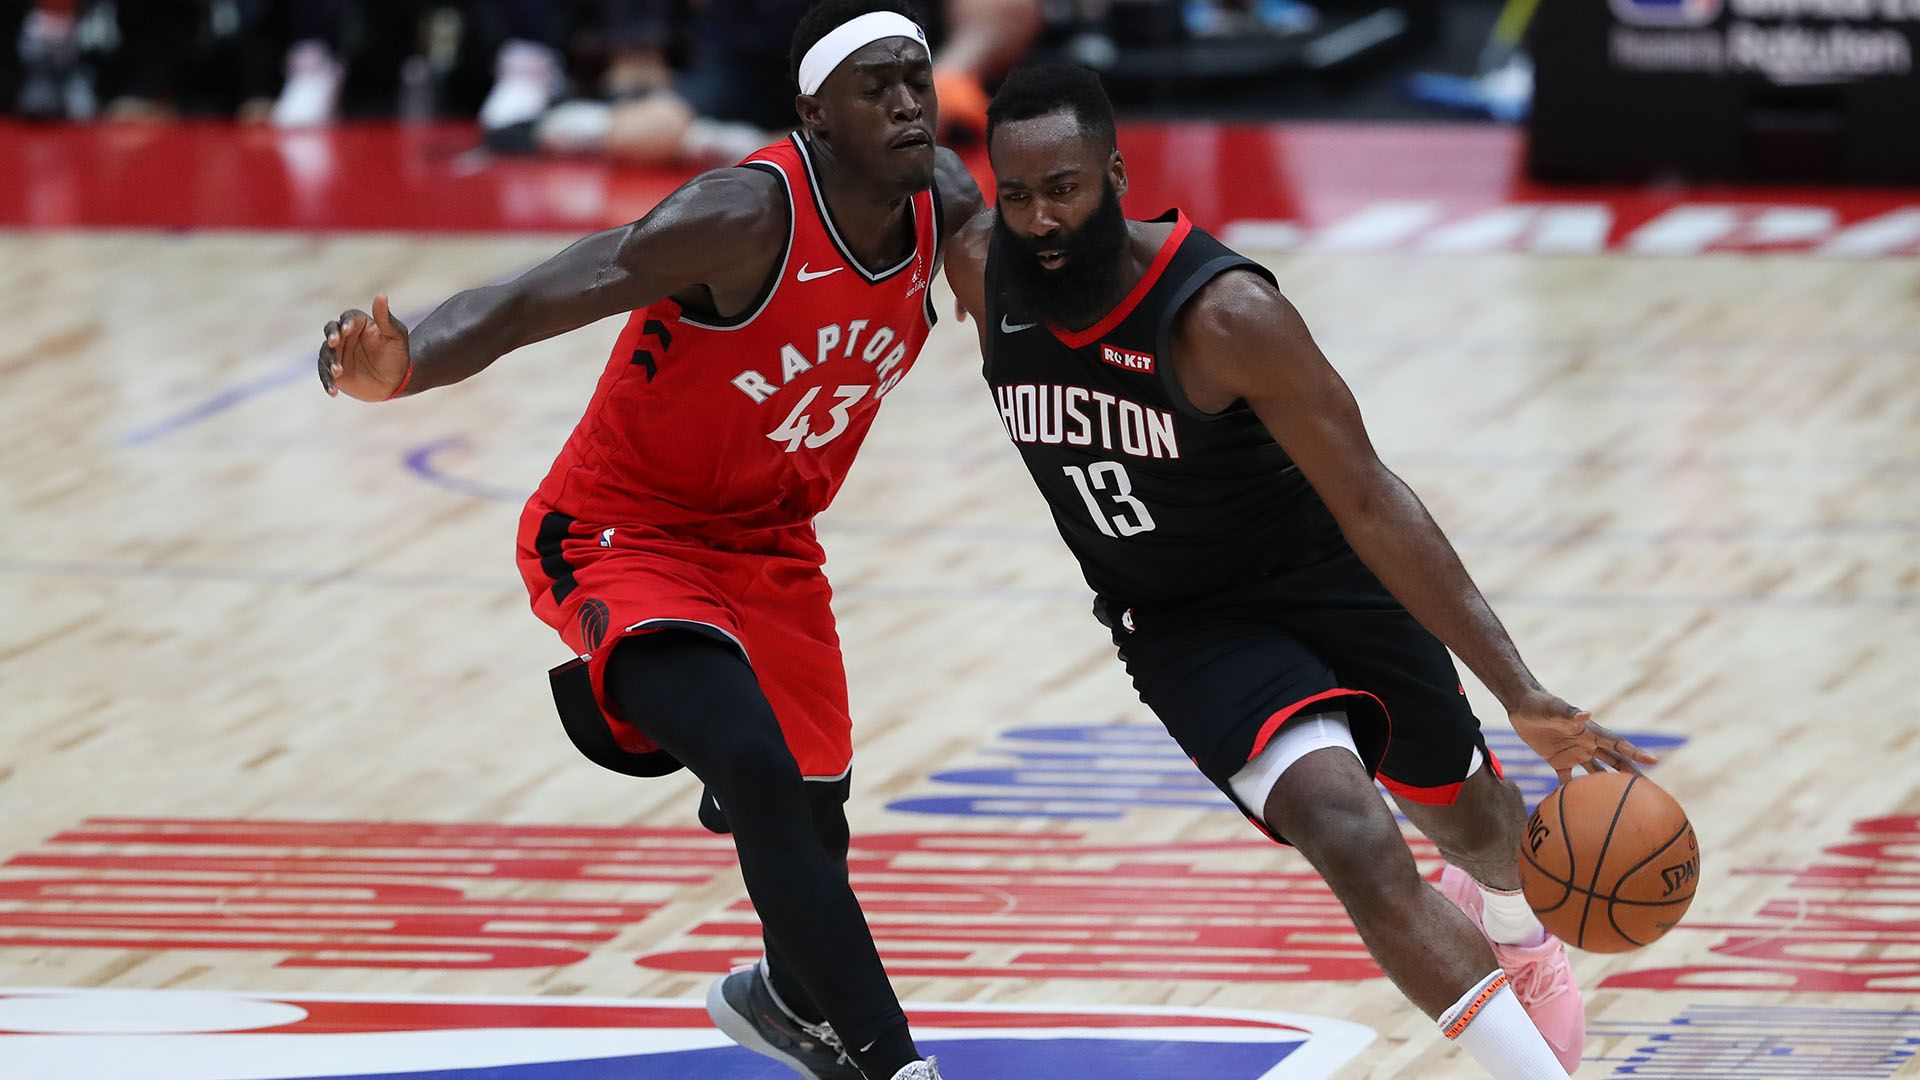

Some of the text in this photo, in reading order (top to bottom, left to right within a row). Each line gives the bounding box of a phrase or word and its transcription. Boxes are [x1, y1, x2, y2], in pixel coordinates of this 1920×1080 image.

[730, 319, 907, 405] RAPTORS
[766, 385, 871, 453] 43
[997, 384, 1181, 460] HOUSTON
[1062, 461, 1157, 539] 13
